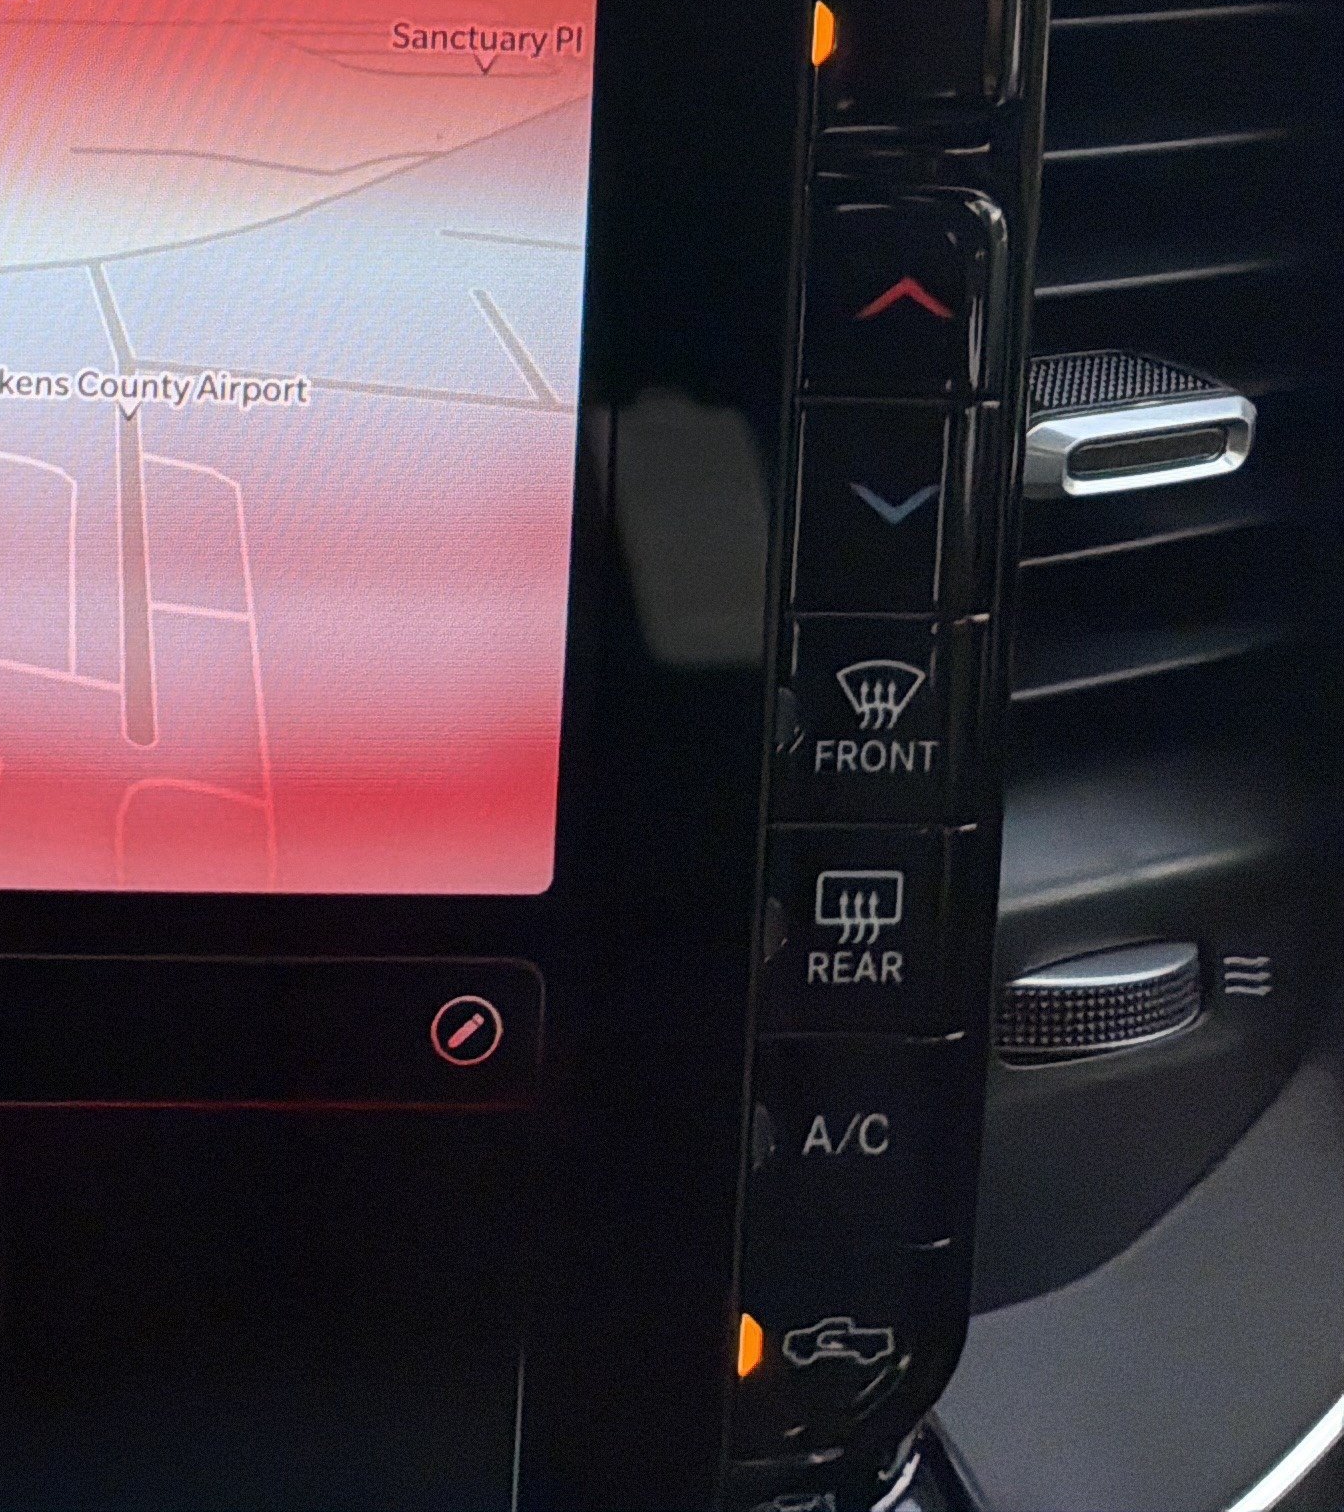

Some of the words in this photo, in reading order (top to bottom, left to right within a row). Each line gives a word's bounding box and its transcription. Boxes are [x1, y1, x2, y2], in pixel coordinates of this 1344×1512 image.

[392, 22, 548, 57] Sanctuary
[77, 371, 192, 405] County
[197, 374, 310, 407] Airport
[815, 739, 940, 773] FRONT
[807, 950, 904, 984] REAR
[802, 1113, 889, 1155] A/C
